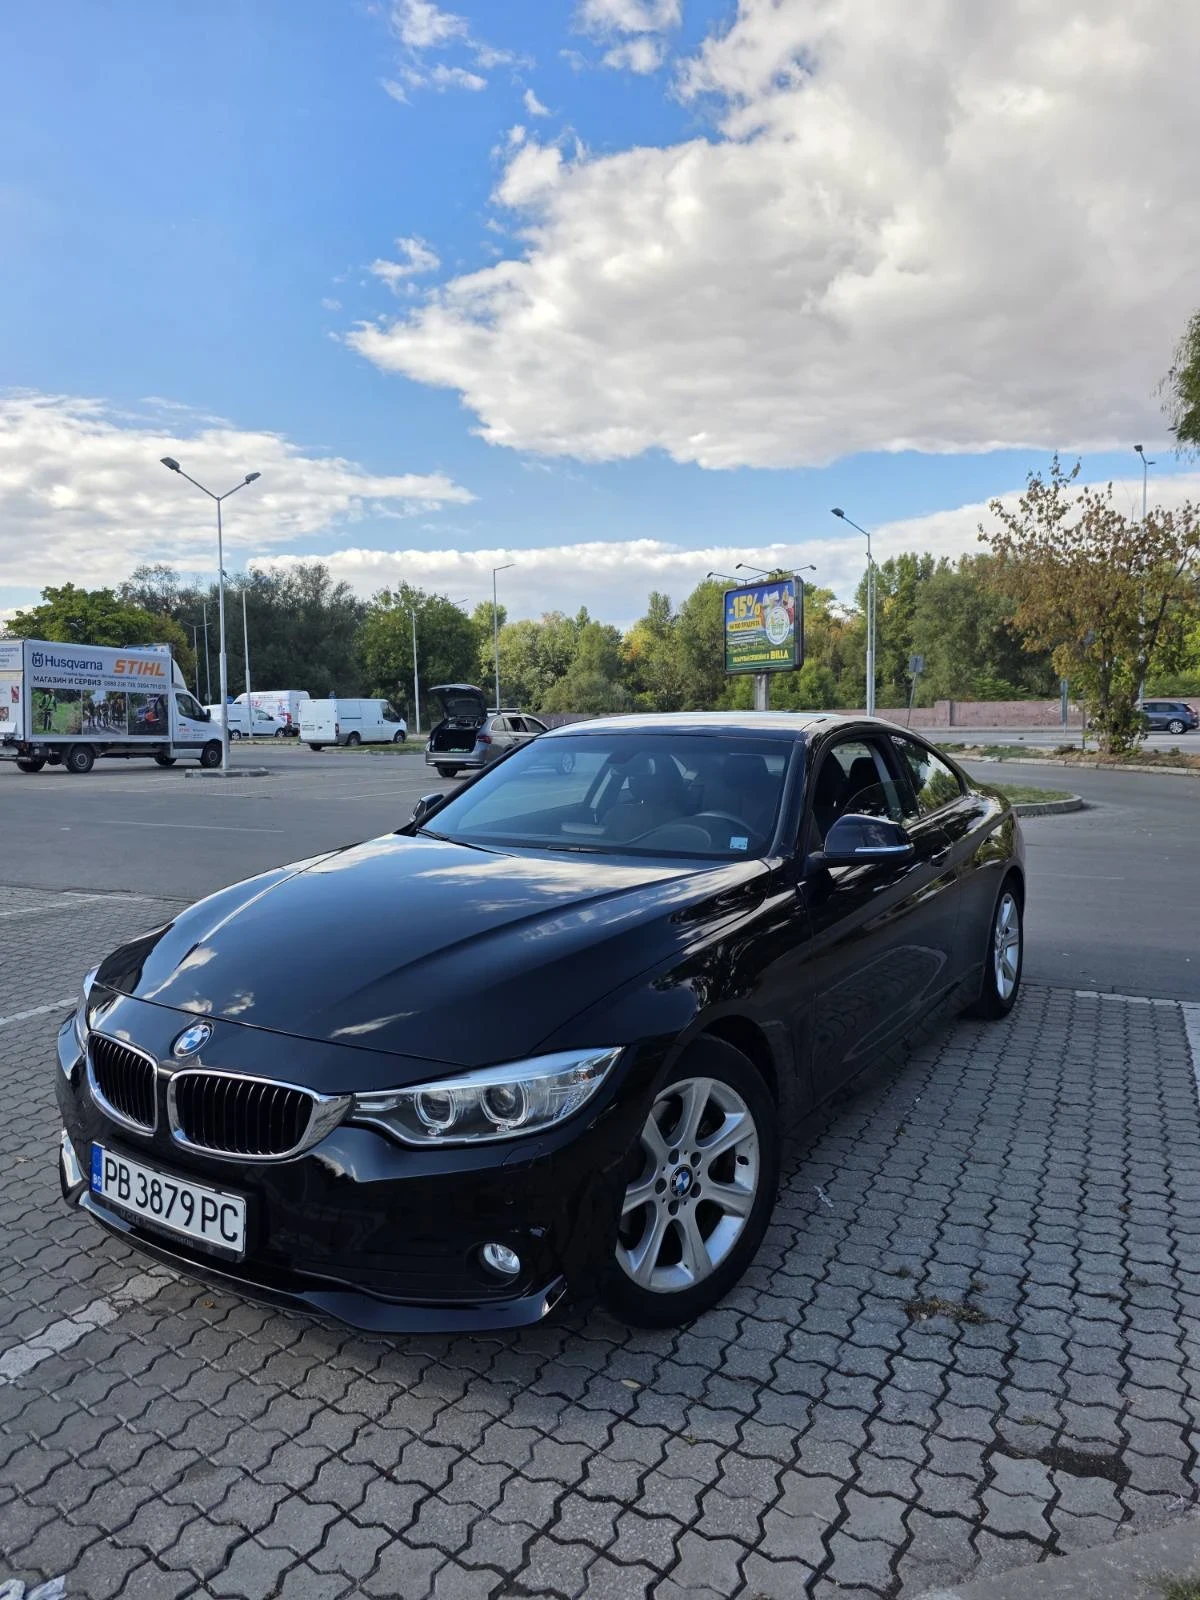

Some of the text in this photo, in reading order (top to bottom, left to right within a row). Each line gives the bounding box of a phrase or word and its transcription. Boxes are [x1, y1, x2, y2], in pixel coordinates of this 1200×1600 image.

[728, 593, 760, 618] -15%
[770, 649, 789, 660] BILLA
[45, 655, 103, 670] Husqvarna
[114, 660, 165, 677] STIHL
[33, 675, 67, 684] МАГАЗИН
[75, 678, 102, 686] СЕРВИЗ
[92, 1172, 102, 1187] BG
[104, 1157, 131, 1201] PB
[135, 1172, 194, 1227] 3879
[201, 1196, 239, 1243] PC
